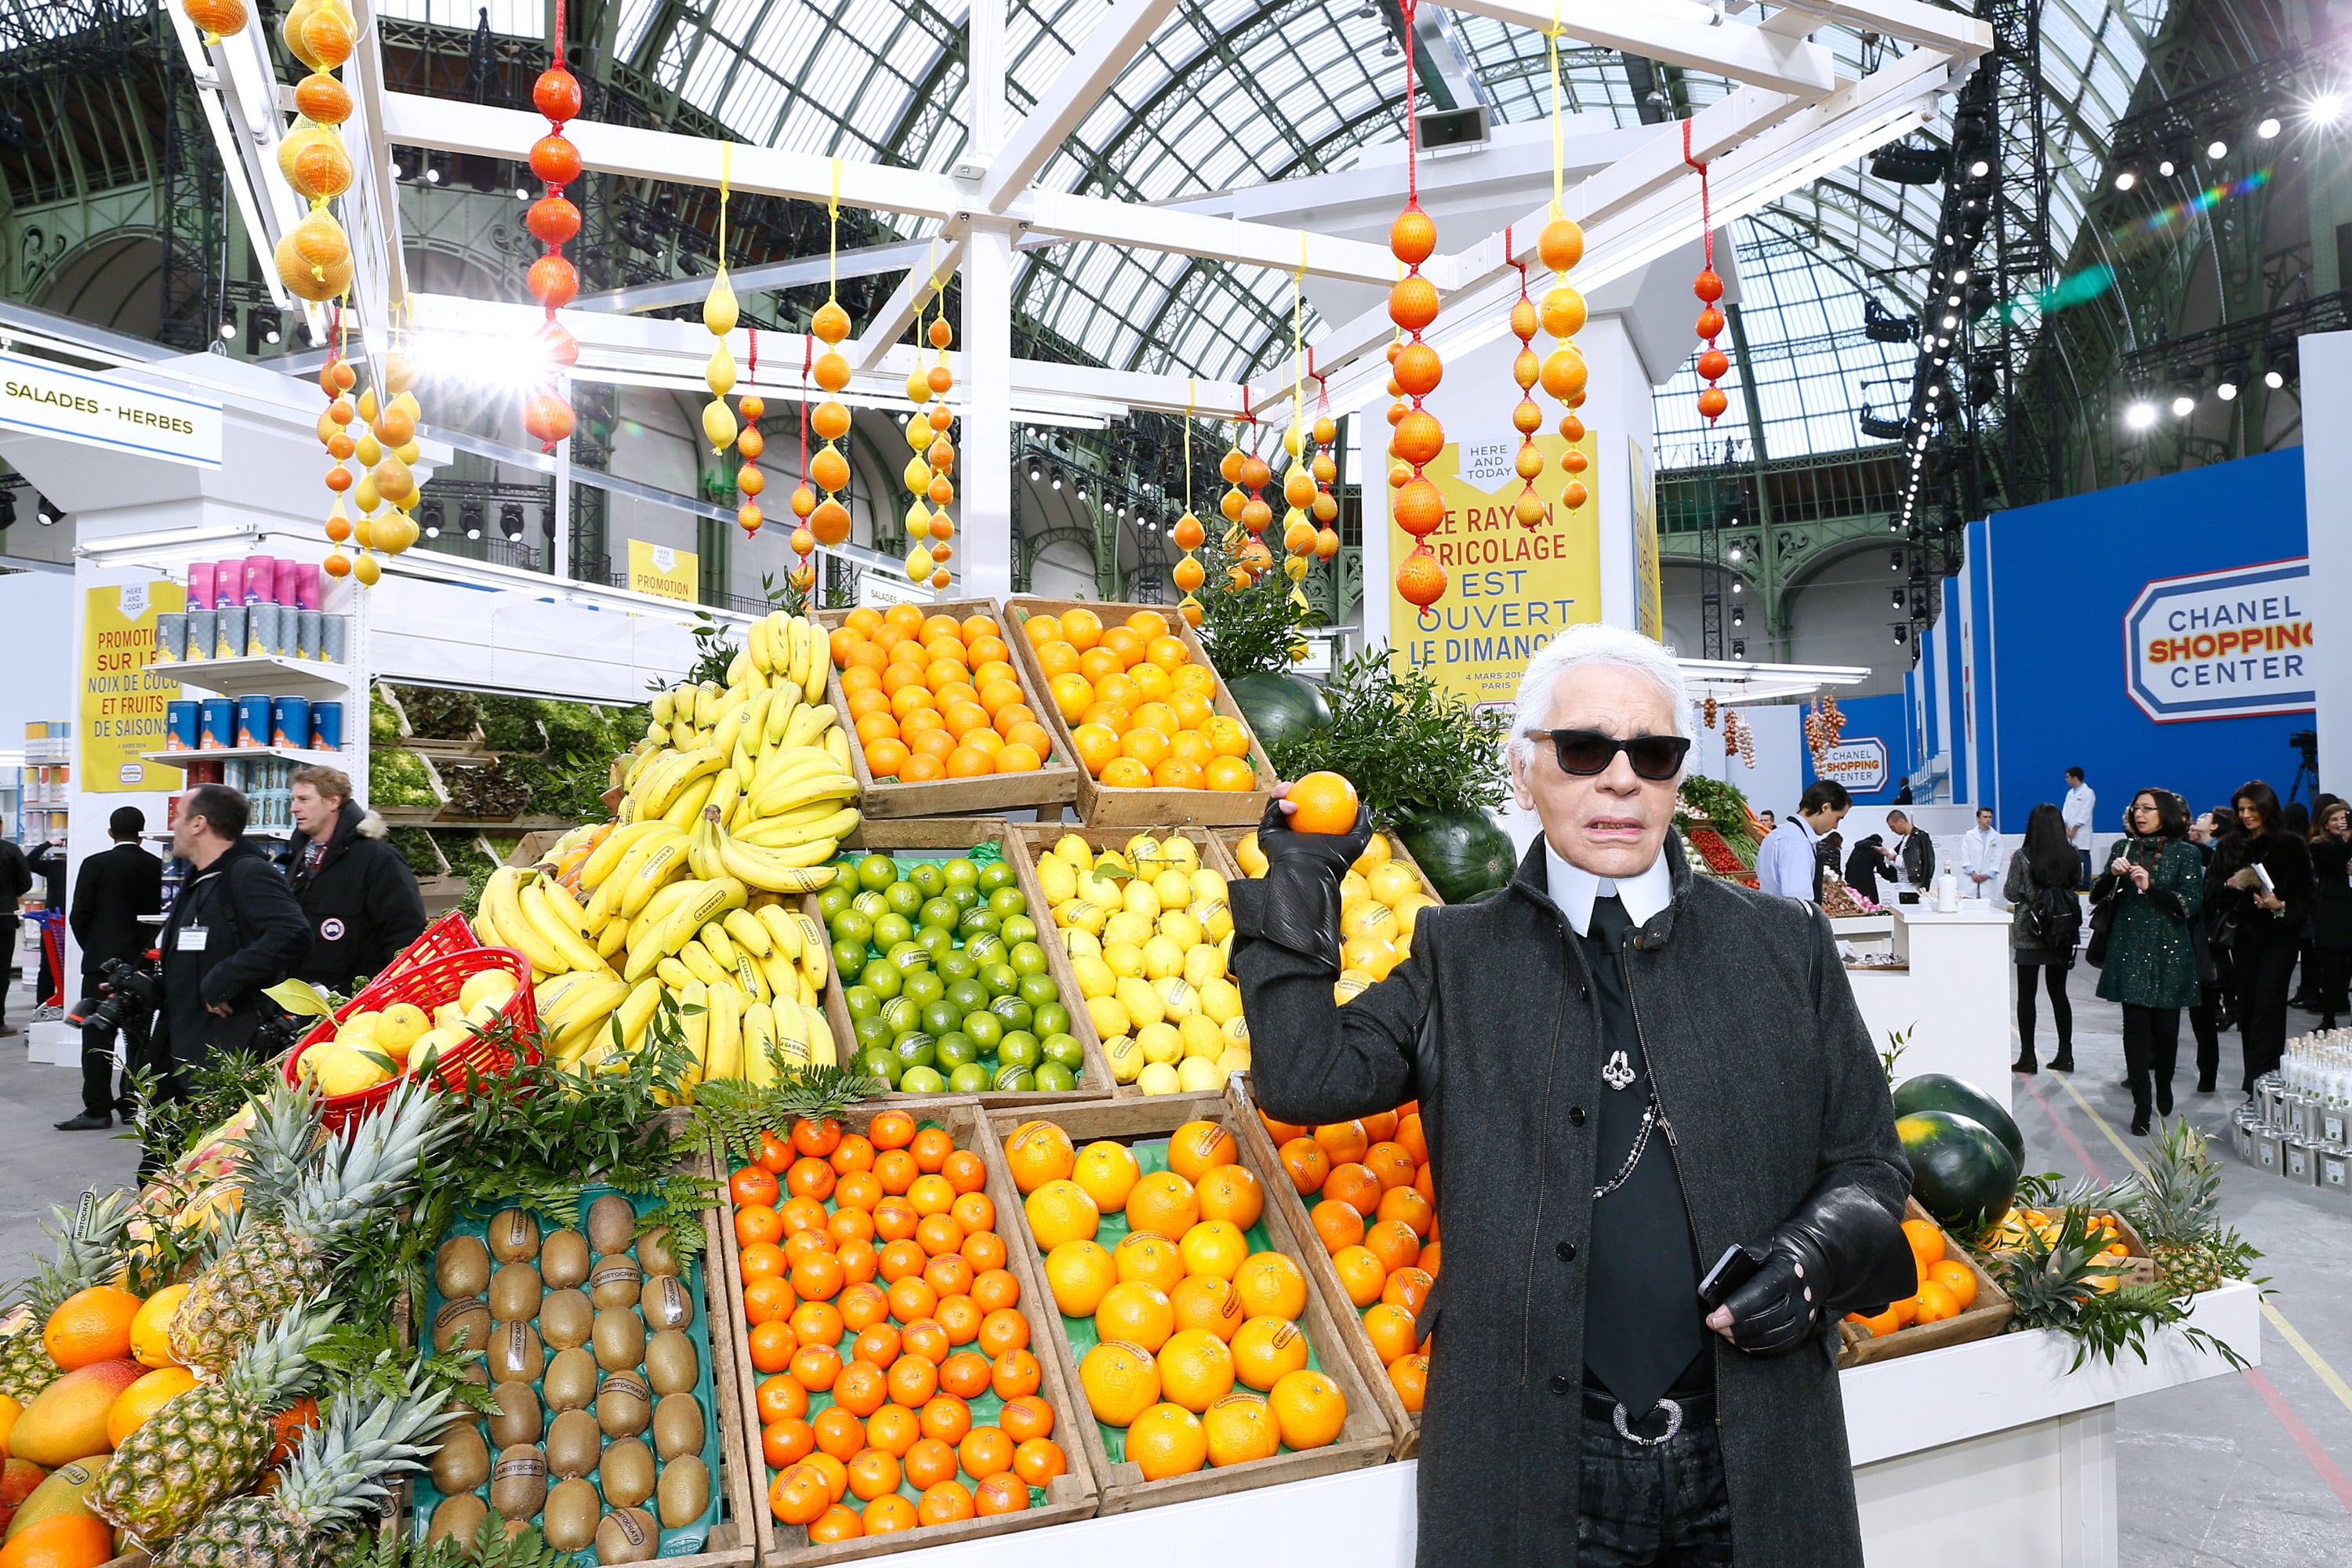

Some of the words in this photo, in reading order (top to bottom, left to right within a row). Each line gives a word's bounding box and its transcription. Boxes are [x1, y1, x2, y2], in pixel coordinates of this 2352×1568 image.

[5, 381, 99, 414] SALADES
[118, 405, 194, 434] HERBES
[1470, 445, 1508, 456] HERE
[1474, 456, 1504, 467] AND
[1467, 467, 1512, 480] TODAY
[1467, 502, 1555, 533] RAYN
[637, 573, 689, 596] PROMOTION
[1461, 569, 1528, 597] EST
[870, 590, 898, 604] SALADES
[1417, 599, 1575, 633] OUVERT
[2169, 596, 2302, 632] CHANEL
[99, 628, 158, 649] PROMOTI
[1410, 640, 1436, 666] LE
[1445, 633, 1556, 663] DIMANC
[96, 652, 132, 672] SUR
[2170, 655, 2304, 688] CENTER
[88, 675, 119, 694] NOIX
[124, 674, 138, 691] DE
[1474, 672, 1503, 681] MARS
[1482, 681, 1512, 690] PARIS
[102, 698, 117, 715] ET
[121, 695, 164, 714] FRUITS
[95, 720, 111, 737] DE
[1832, 750, 1872, 760] CHANEL
[1826, 760, 1880, 772] SHOPPING
[1833, 771, 1873, 782] CENTER
[702, 892, 726, 913] GABRIELLE
[77, 1194, 92, 1239] RISTOCRATE
